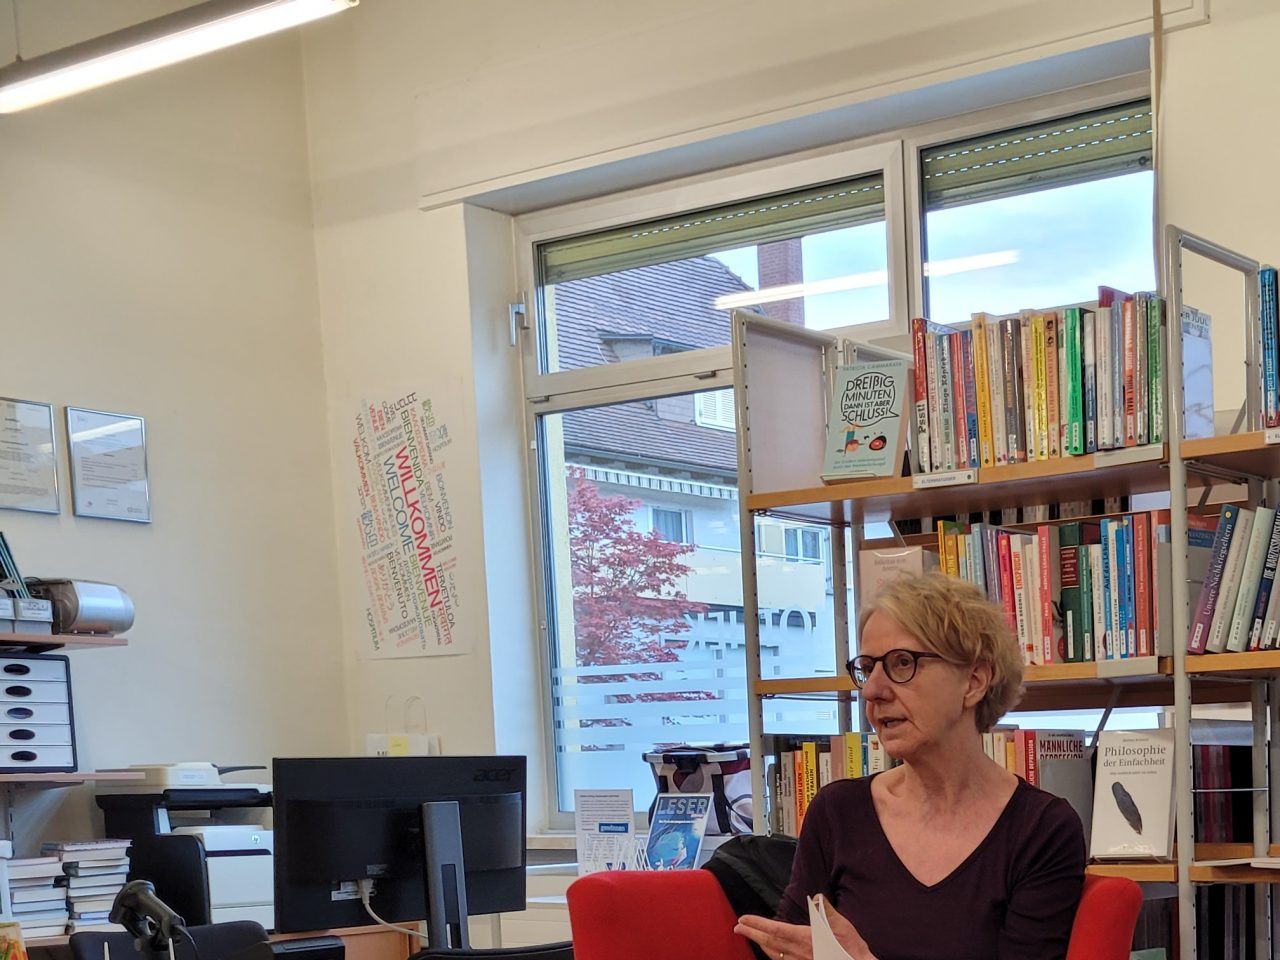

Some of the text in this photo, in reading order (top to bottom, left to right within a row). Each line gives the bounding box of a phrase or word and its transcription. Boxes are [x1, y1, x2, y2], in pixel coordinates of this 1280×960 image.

[1191, 312, 1209, 326] JUUL
[844, 402, 864, 410] DANN
[874, 399, 890, 407] ABER
[916, 403, 927, 434] Psst!
[400, 409, 424, 488] BIENVENIDA
[383, 454, 415, 556] WELCOME
[395, 445, 443, 608] WILLKOMMEN
[1013, 551, 1023, 590] EINSPRUCH!
[1203, 523, 1232, 615] Unsere Nachkriegseltern
[1264, 567, 1275, 580] DIE
[386, 551, 408, 619] BENVENUTO
[1039, 738, 1083, 753] MÄNNLICHE
[1104, 744, 1166, 757] Philosophie
[1103, 757, 1166, 767] der Einfachheit
